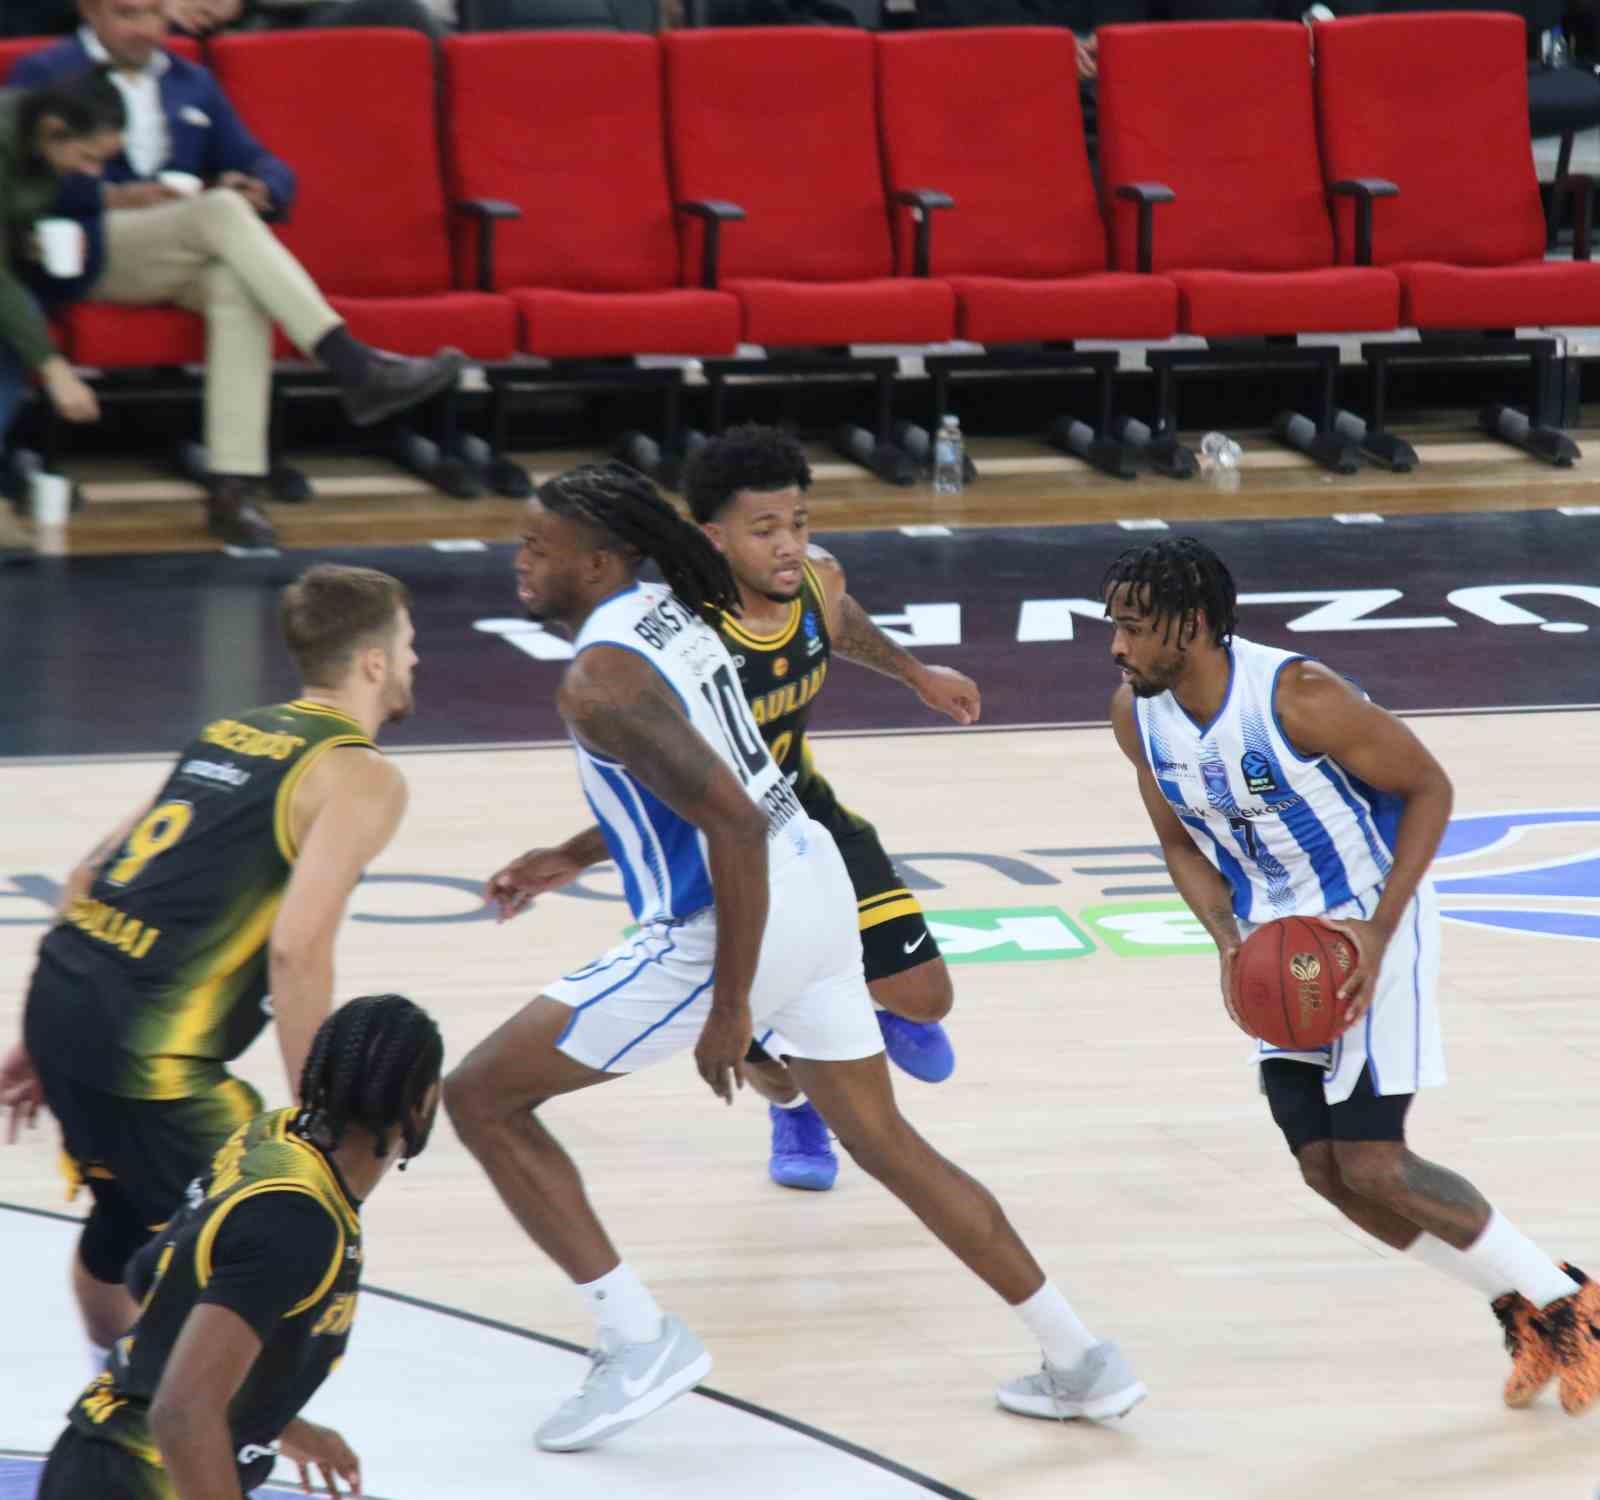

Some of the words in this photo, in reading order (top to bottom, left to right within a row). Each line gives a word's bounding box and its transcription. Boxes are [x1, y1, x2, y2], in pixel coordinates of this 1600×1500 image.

[700, 663, 769, 786] 10
[105, 799, 195, 887] 9
[1229, 815, 1259, 860] 7
